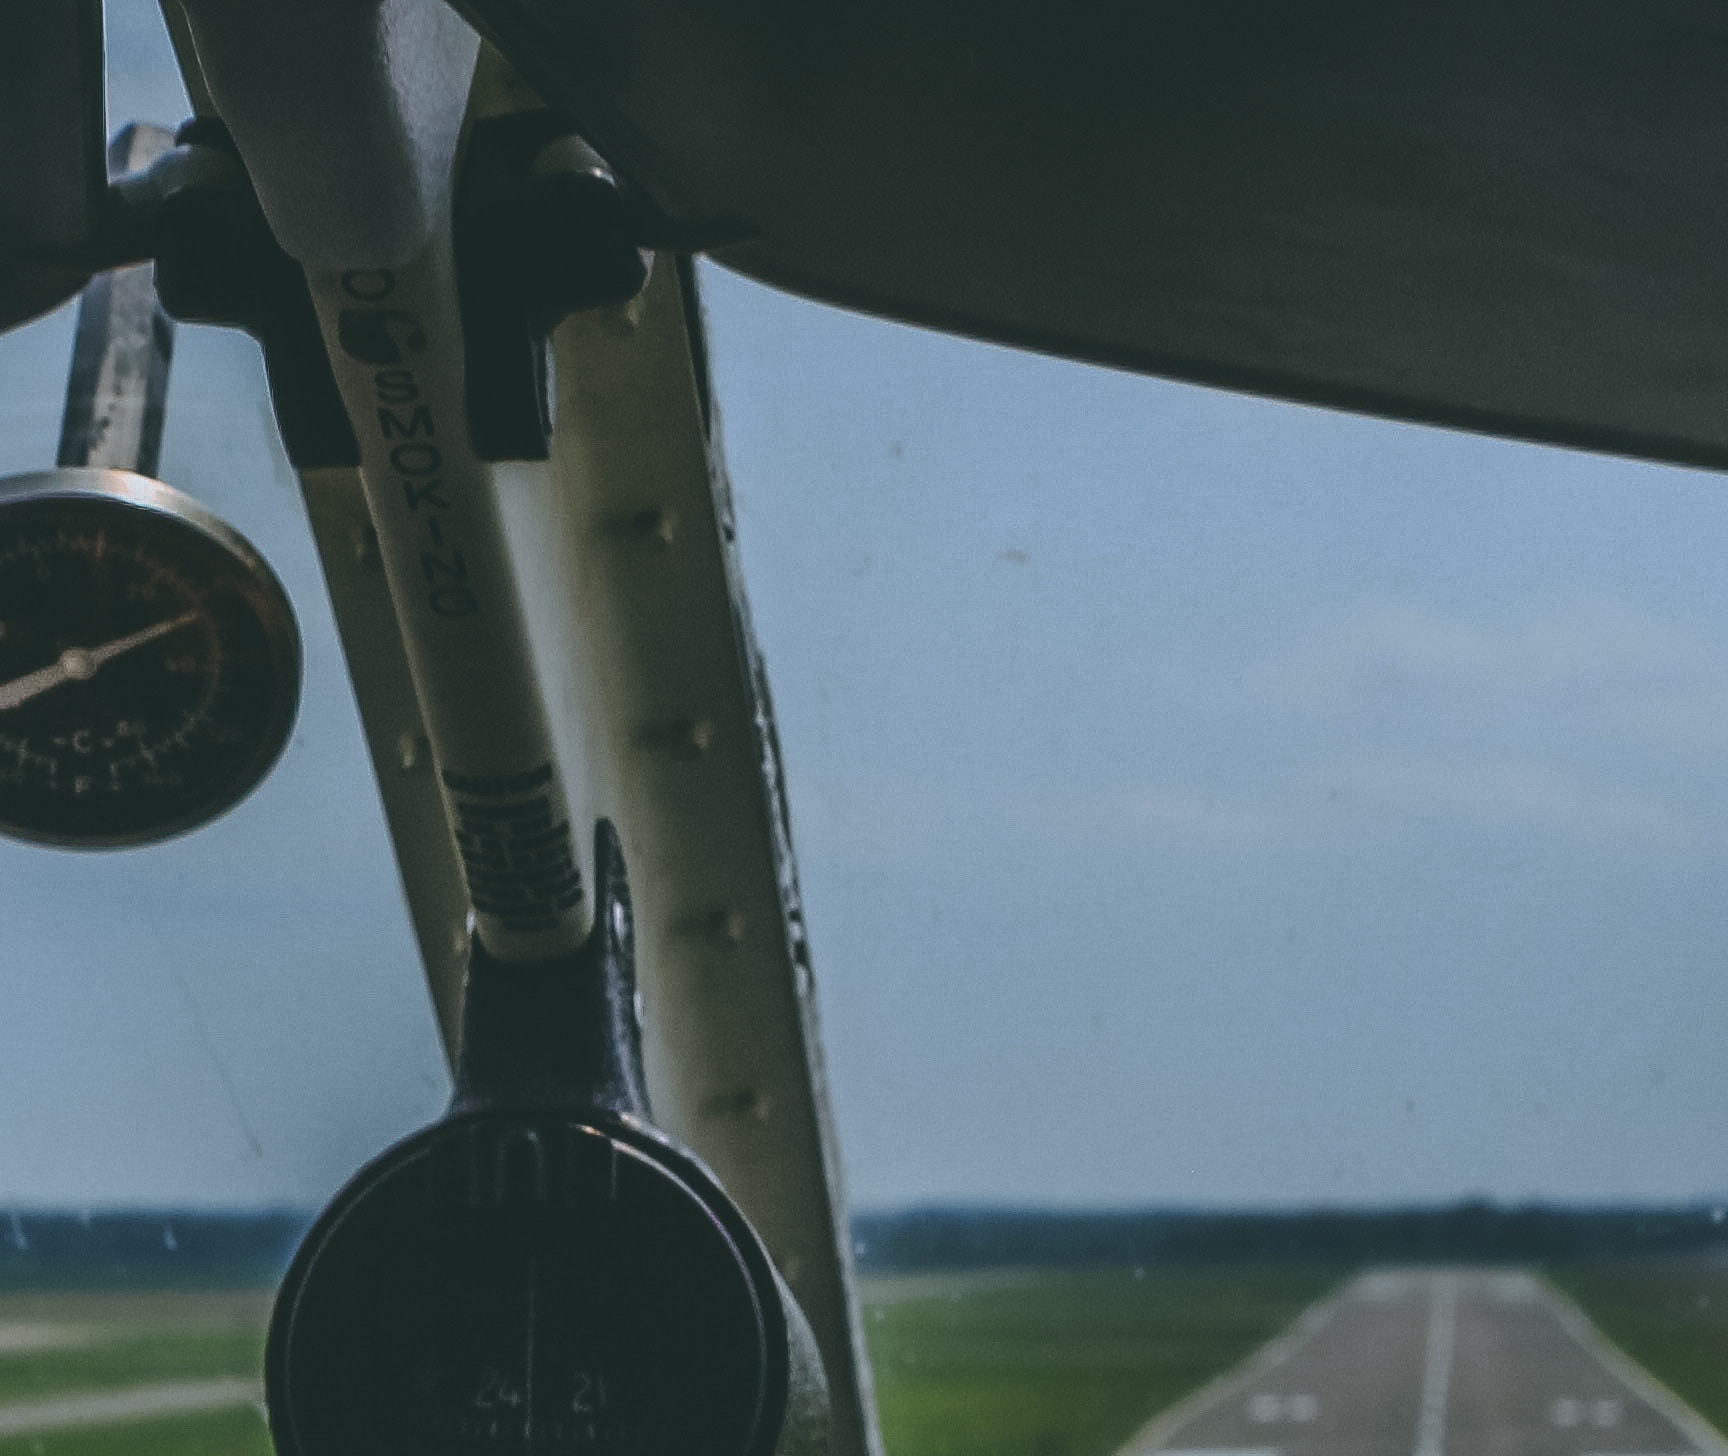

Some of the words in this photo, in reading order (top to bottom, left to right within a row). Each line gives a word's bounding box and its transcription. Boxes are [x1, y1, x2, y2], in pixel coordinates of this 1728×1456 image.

[375, 368, 478, 621] SMOKING
[475, 1365, 522, 1409] 24
[571, 1371, 607, 1413] 21
